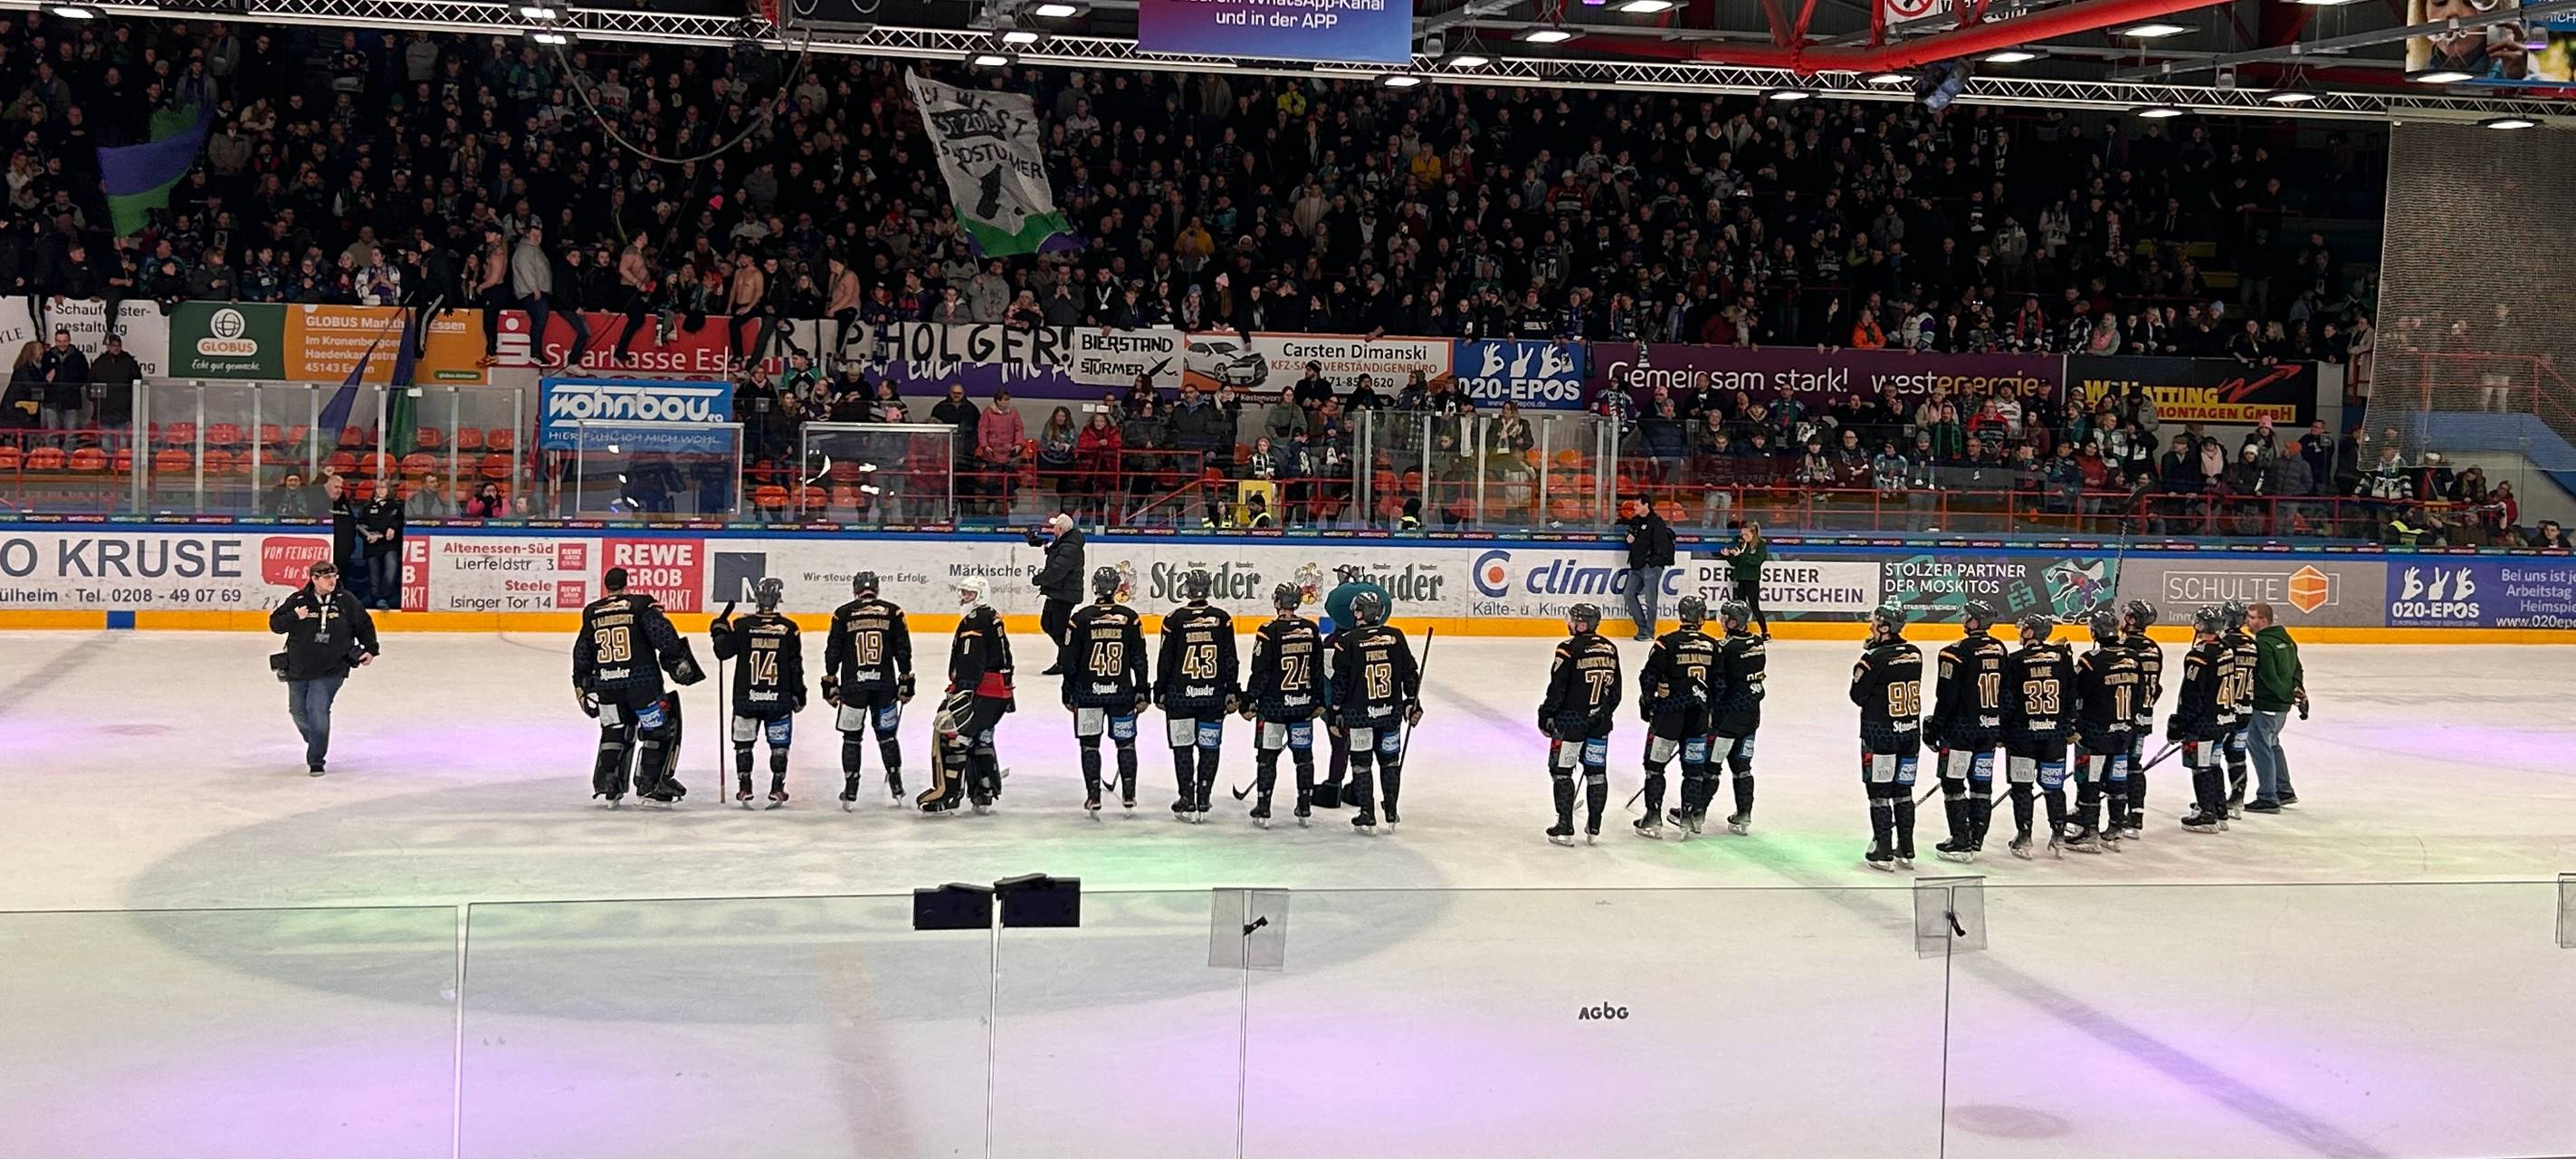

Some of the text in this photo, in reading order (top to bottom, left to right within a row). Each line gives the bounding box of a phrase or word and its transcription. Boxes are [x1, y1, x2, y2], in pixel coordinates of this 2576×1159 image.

[1216, 10, 1338, 29] und in der APP
[305, 315, 358, 328] GLOBUS
[201, 340, 254, 353] GLOBUS
[1283, 341, 1427, 360] Carsten Dimanski
[210, 361, 224, 372] gut
[304, 363, 340, 373] 45143
[1774, 368, 1848, 393] stark!
[549, 431, 579, 441] HIER
[681, 433, 721, 444] WOHL
[263, 545, 329, 560] VOM FEINSTEN
[444, 542, 554, 554] Altenessen-Süd
[614, 544, 693, 565] REWE
[58, 539, 242, 578] KRUSE
[546, 558, 555, 571] 3
[283, 566, 301, 580] für
[626, 569, 682, 587] GROB
[804, 572, 821, 582] Wir
[897, 572, 930, 584] Erfolg.
[949, 564, 1022, 578] Märkische
[1884, 562, 2027, 579] STOLZER PARTNER
[2502, 569, 2522, 582] Bei
[2524, 572, 2547, 582] uns
[2550, 569, 2566, 582] ist
[505, 580, 552, 591] Steele
[1884, 580, 1999, 594] DER MOSKITOS
[2169, 578, 2279, 601] SCHULTE
[2505, 584, 2572, 599] Arbeitstag
[76, 589, 105, 602] Tel.
[111, 589, 152, 602] 0208
[169, 589, 189, 602] 49
[196, 589, 215, 602] 07
[221, 589, 242, 602] 69
[451, 596, 501, 611] Isinger
[504, 597, 530, 608] Tor
[534, 597, 551, 608] 14
[1473, 600, 1516, 616] Kälte-
[2391, 601, 2480, 618] 020-EPOS
[595, 627, 632, 664] 39
[855, 631, 883, 666] 19
[1090, 642, 1124, 677] 48
[1182, 645, 1218, 679] 43
[749, 651, 779, 685] 14
[1281, 656, 1312, 691] 24
[1365, 663, 1392, 700] 13
[2023, 680, 2060, 715] 33
